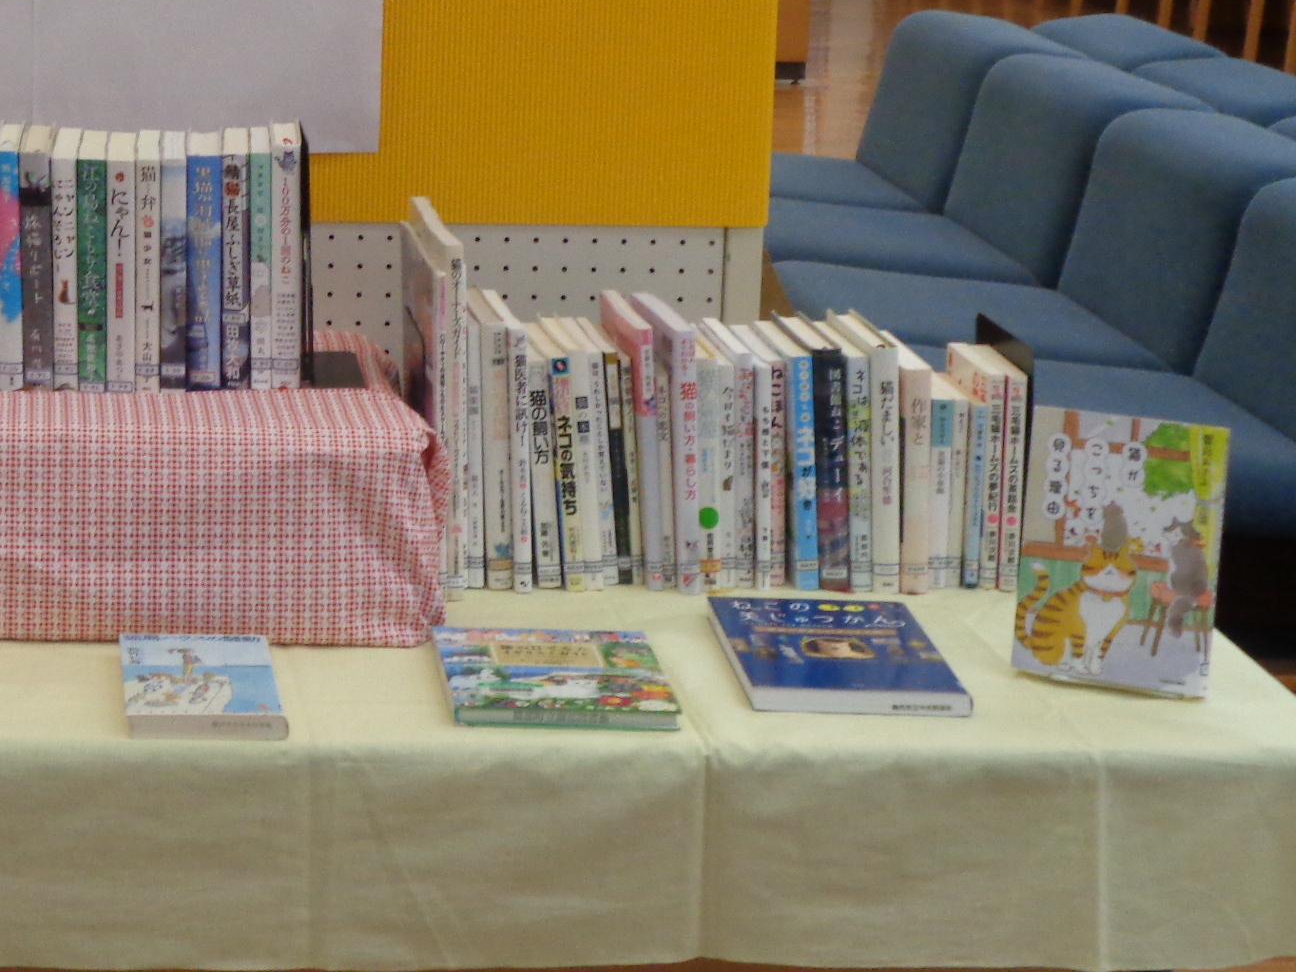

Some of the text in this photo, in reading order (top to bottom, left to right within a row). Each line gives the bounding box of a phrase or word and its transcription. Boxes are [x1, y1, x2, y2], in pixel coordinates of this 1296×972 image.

[529, 389, 549, 465] 猫の飼い方
[557, 415, 578, 516] ネコの気持ち
[680, 381, 699, 501] 猫の飼い方・暮らし方
[1127, 446, 1142, 482] 猫が
[1045, 439, 1066, 516] 見る理由
[1087, 442, 1103, 520] こっちを
[732, 599, 811, 613] ねこの
